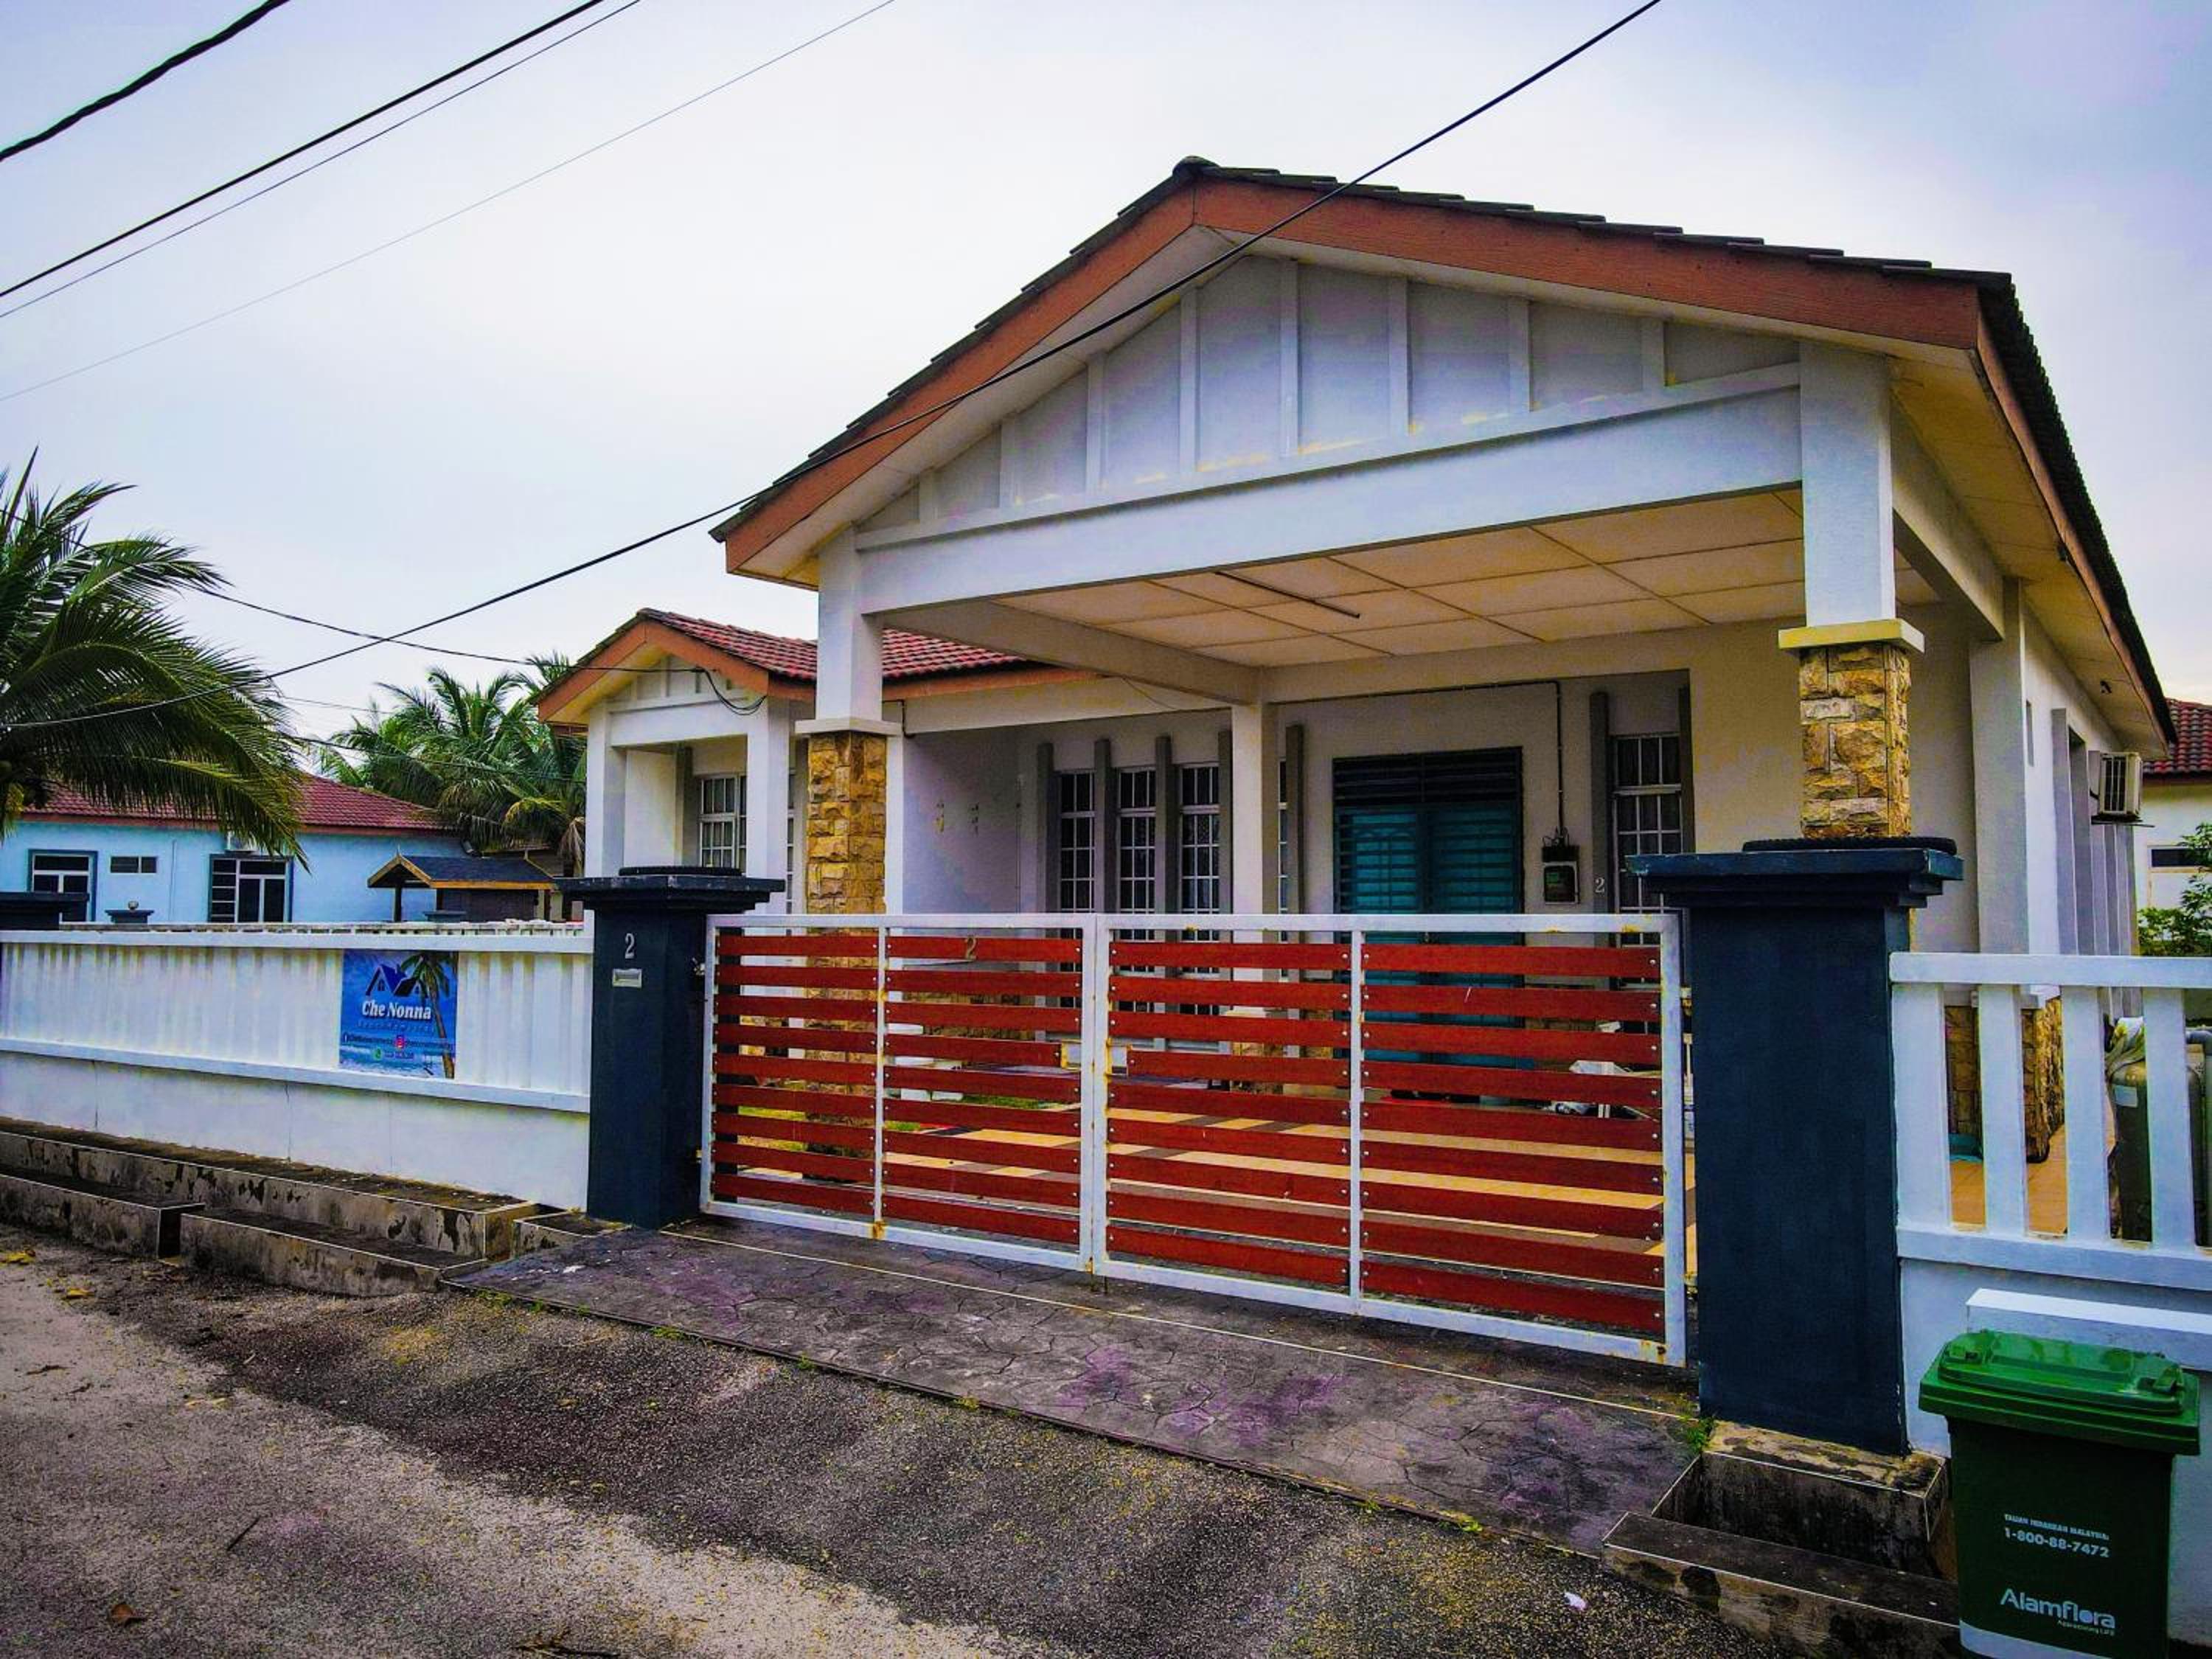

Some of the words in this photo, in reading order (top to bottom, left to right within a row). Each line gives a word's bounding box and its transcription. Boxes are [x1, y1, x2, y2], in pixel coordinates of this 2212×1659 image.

[1595, 877, 1605, 893] 2
[625, 933, 635, 959] 2
[964, 936, 977, 960] 2
[362, 1000, 386, 1017] Che
[387, 1002, 431, 1020] Nonna
[2004, 1527, 2110, 1558] 1-800-88-7472
[2000, 1588, 2115, 1629] Alamflora
